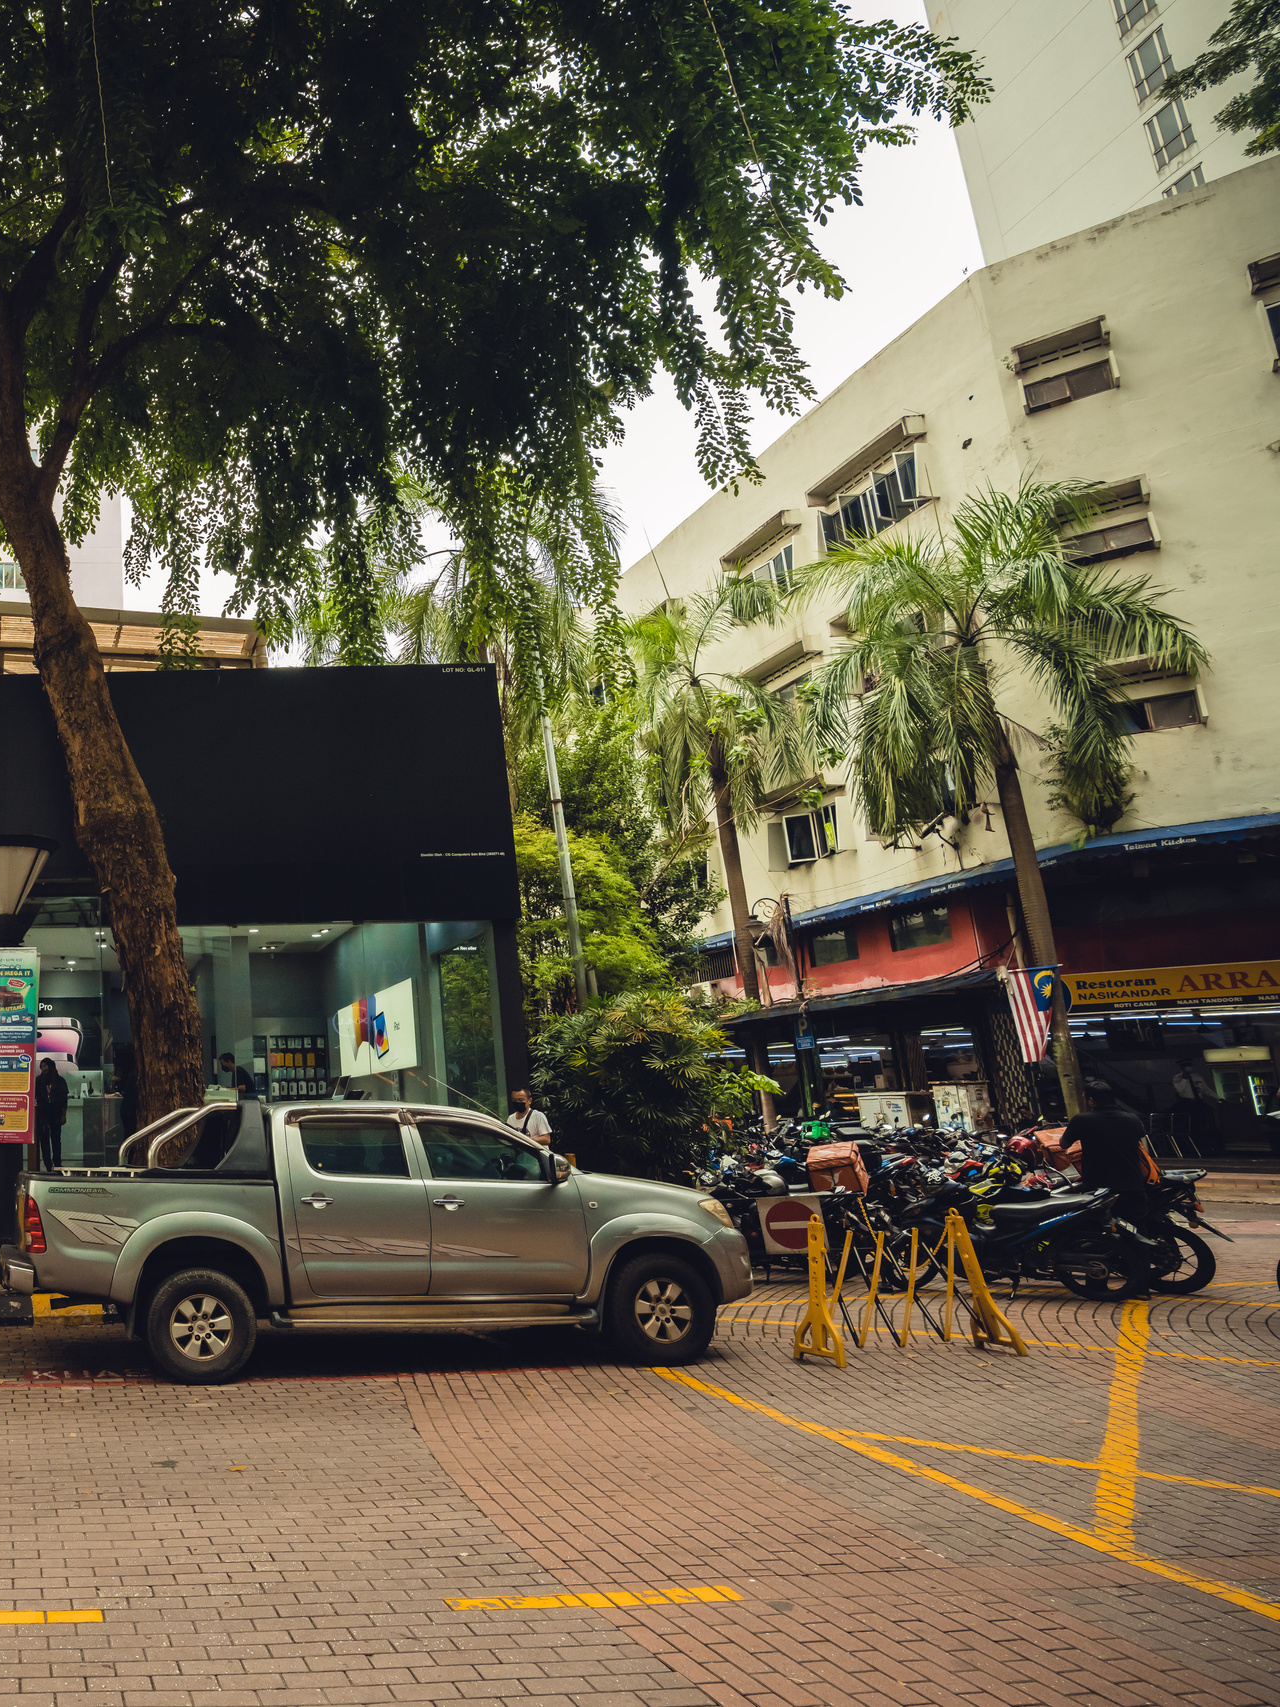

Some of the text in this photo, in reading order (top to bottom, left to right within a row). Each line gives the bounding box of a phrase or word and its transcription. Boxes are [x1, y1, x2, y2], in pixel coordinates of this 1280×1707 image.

[1123, 836, 1197, 851] Taiwan Kitchen
[1075, 977, 1157, 990] Restoran
[1078, 988, 1172, 1001] NASIKANDAR
[1200, 996, 1243, 1004] TANDOORI
[39, 1003, 53, 1011] Pro
